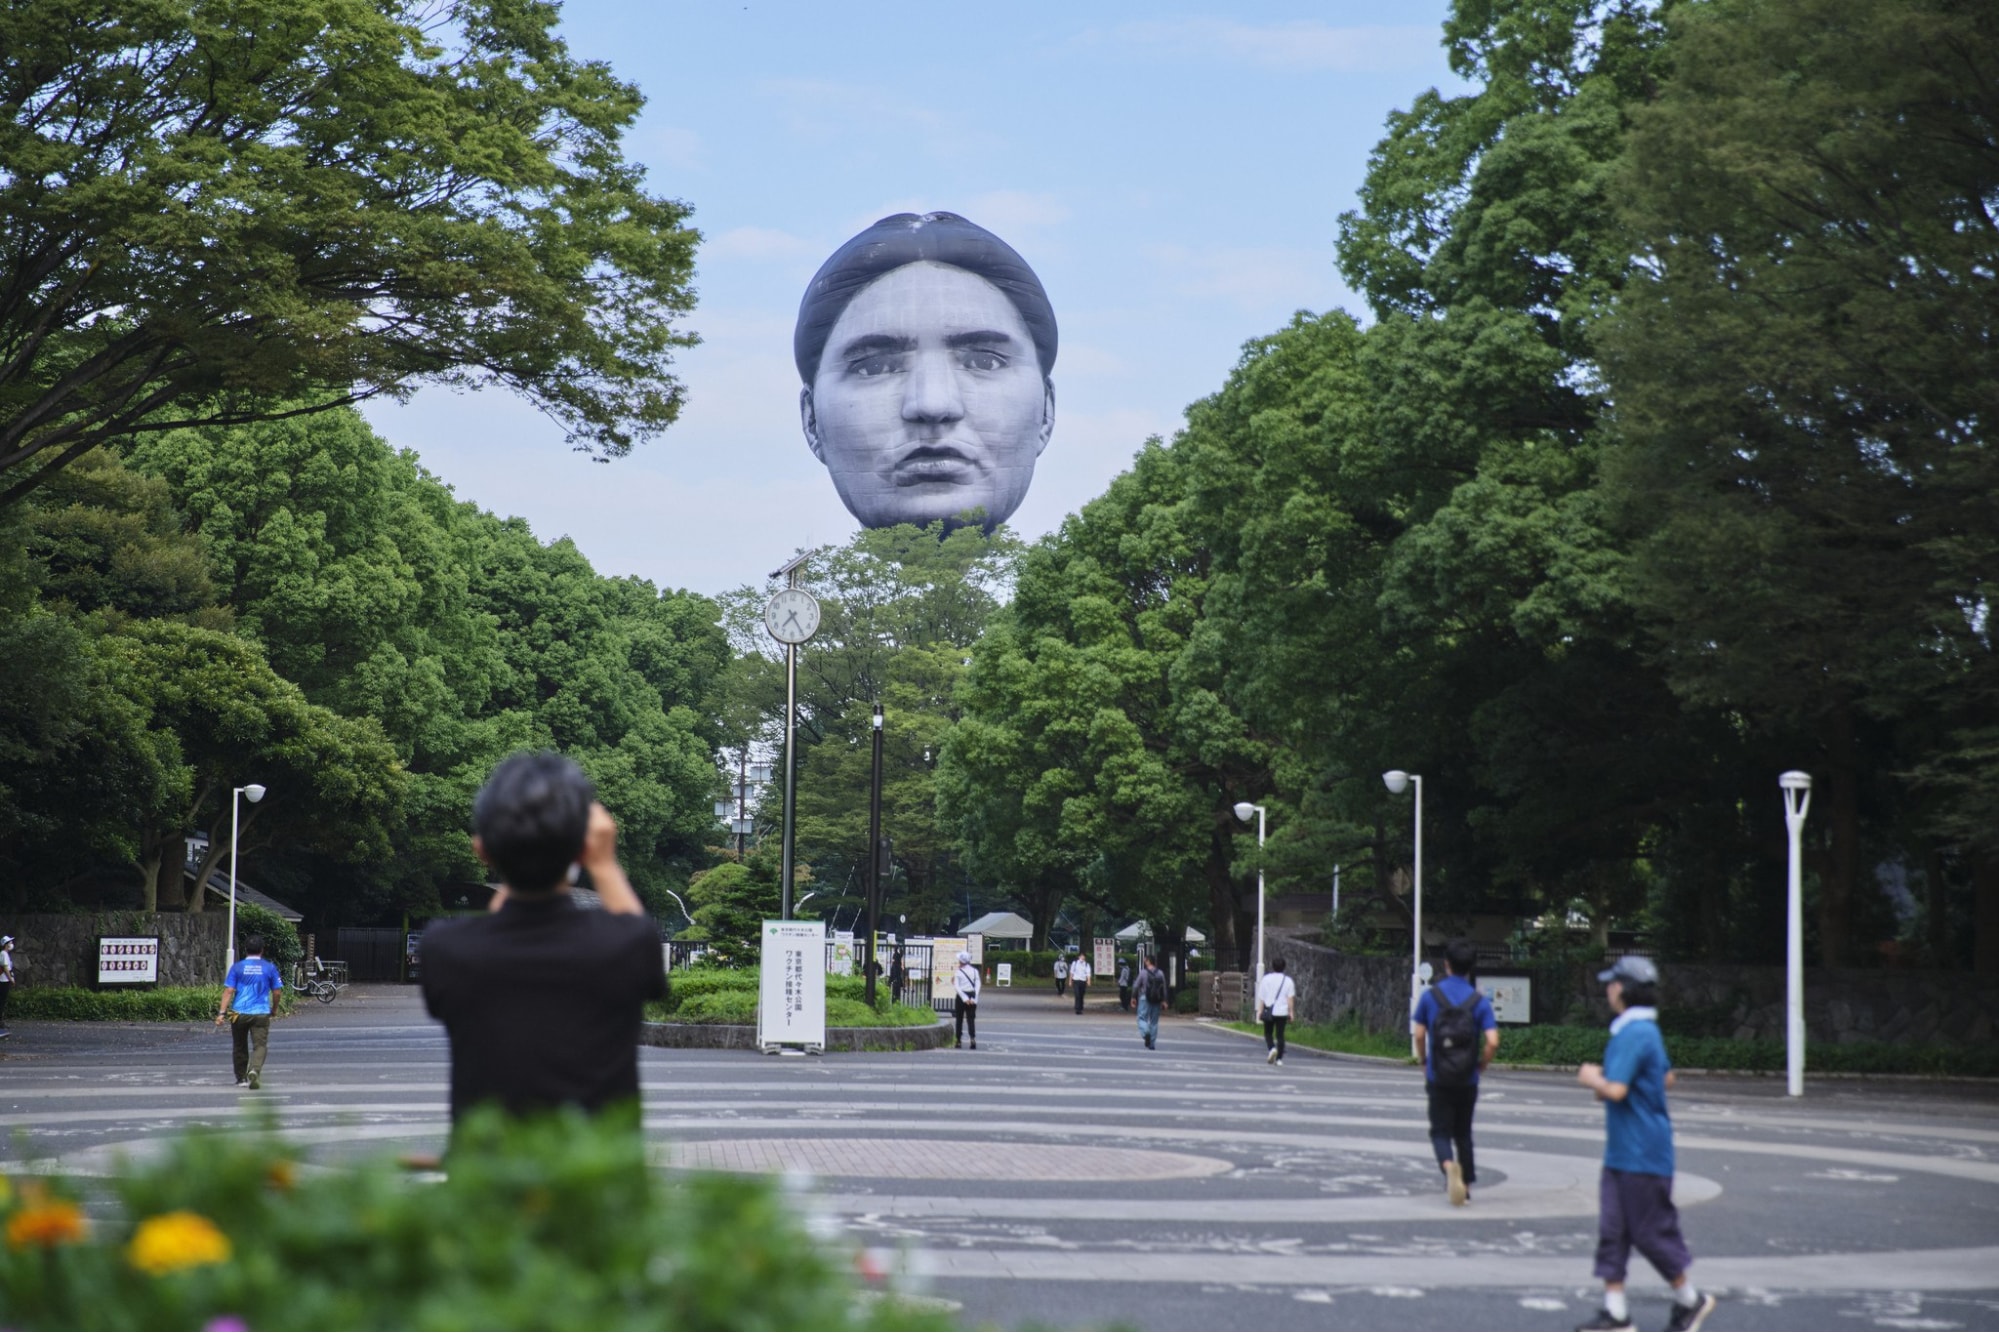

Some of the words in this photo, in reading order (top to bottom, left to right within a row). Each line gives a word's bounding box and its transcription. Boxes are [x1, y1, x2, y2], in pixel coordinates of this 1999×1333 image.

[781, 596, 787, 604] 11
[790, 593, 796, 601] 12
[807, 602, 812, 610] 2
[771, 612, 776, 620] 9
[794, 950, 803, 1011] 東京都代々木公園
[785, 950, 793, 1026] ワクチン接種センター
